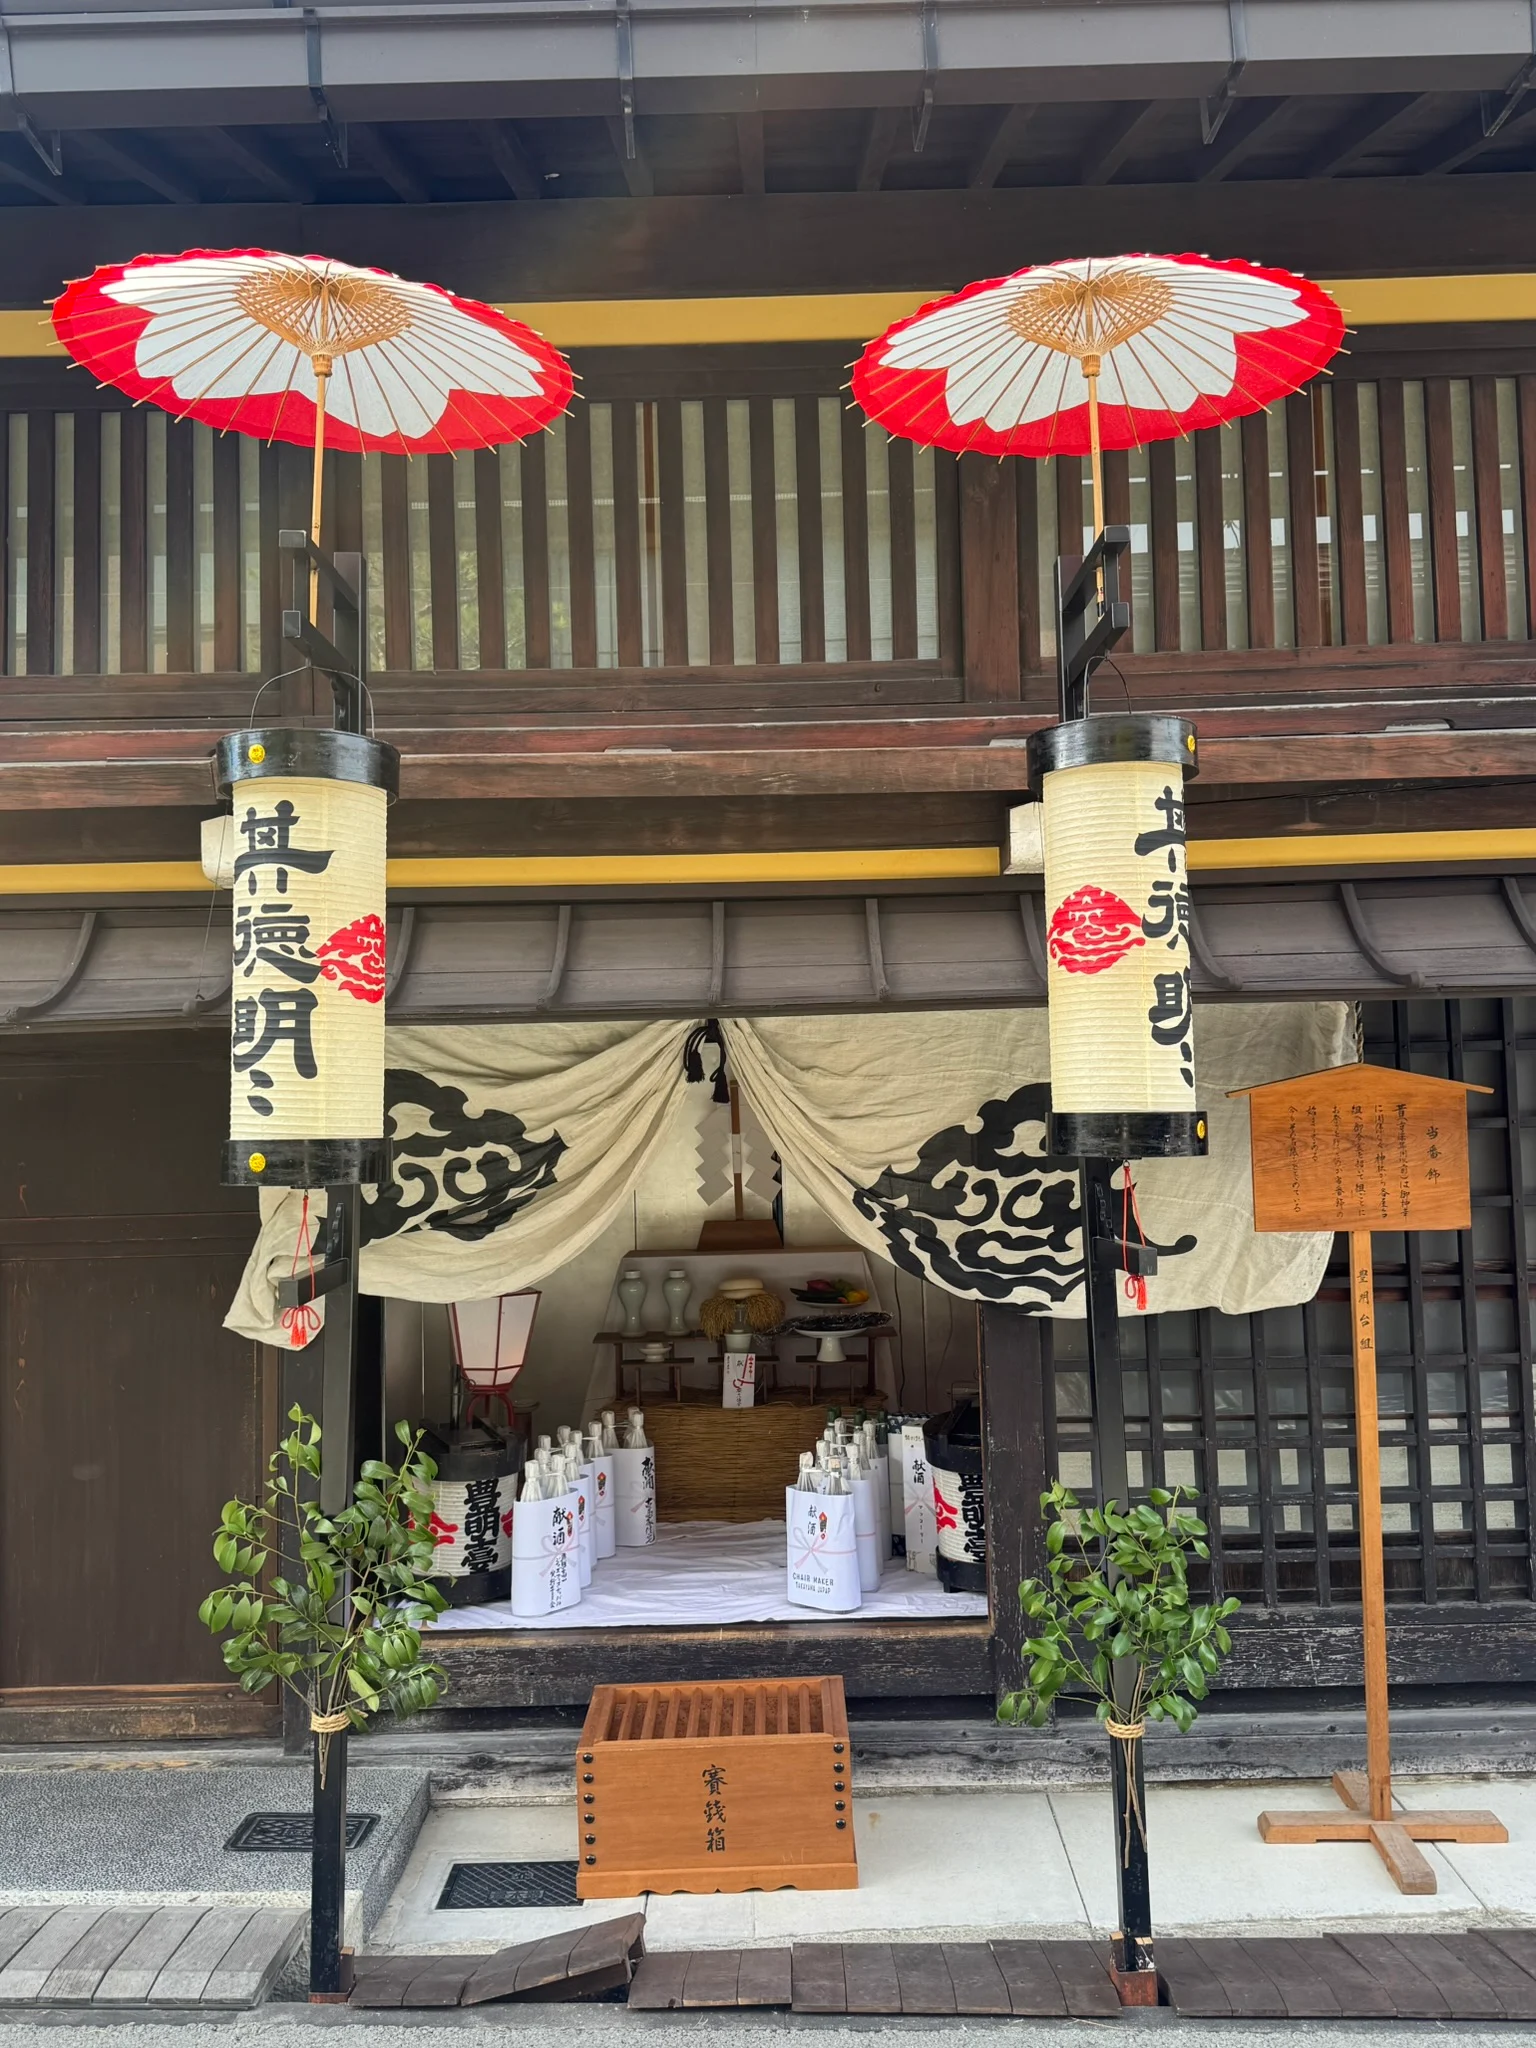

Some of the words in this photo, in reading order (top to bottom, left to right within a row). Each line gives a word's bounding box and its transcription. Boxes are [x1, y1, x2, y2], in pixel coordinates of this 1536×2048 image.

[1424, 1125, 1442, 1185] 当番飾
[912, 1459, 926, 1485] 献酒
[552, 1506, 569, 1546] 献酒
[808, 1504, 818, 1537] 献酒
[793, 1572, 811, 1583] CHAIR
[813, 1576, 834, 1586] MAKER
